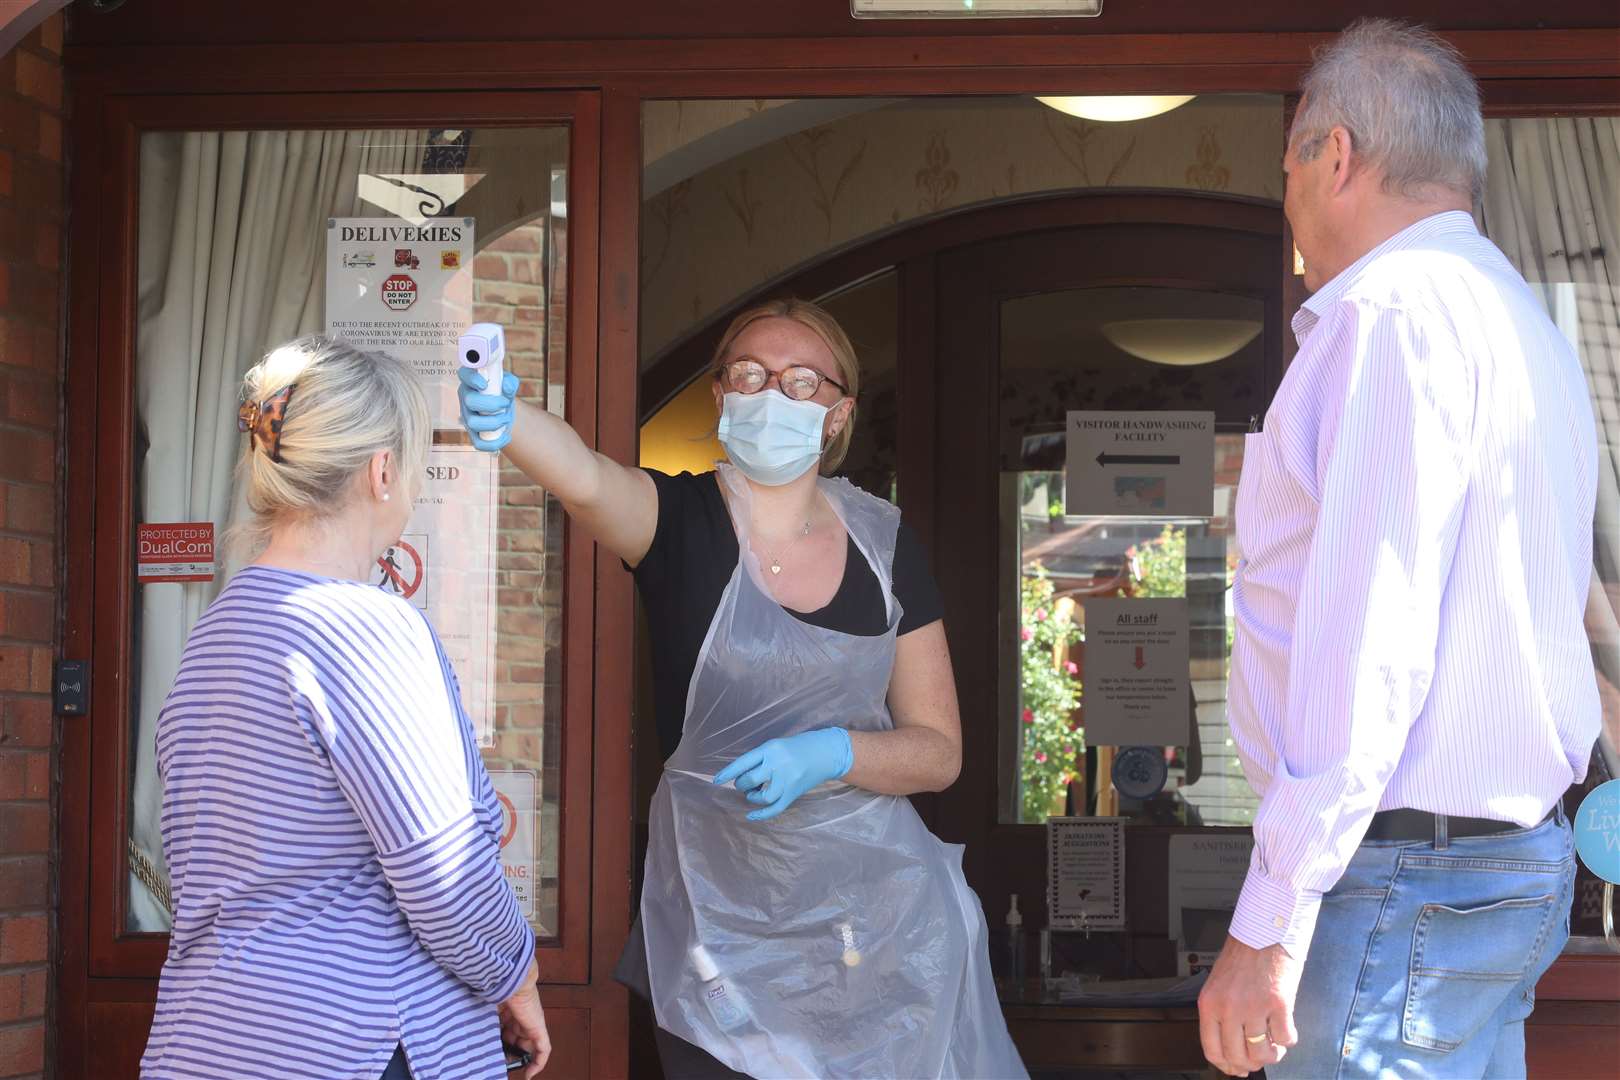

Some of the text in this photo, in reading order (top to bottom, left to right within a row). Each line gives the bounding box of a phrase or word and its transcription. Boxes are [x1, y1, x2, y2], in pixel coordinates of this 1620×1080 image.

[341, 226, 462, 241] DELIVERIES
[386, 280, 413, 290] STOP
[1075, 420, 1207, 431] VISITOR HANDWASHING
[1114, 432, 1165, 441] FACILITY
[426, 466, 460, 480] SED
[140, 529, 212, 539] PROTECTED BY
[140, 540, 212, 554] DualCom
[1117, 612, 1158, 624] All staff
[1586, 808, 1620, 831] Liv
[1602, 831, 1620, 852] W
[504, 866, 529, 878] ING.
[515, 885, 523, 893] to
